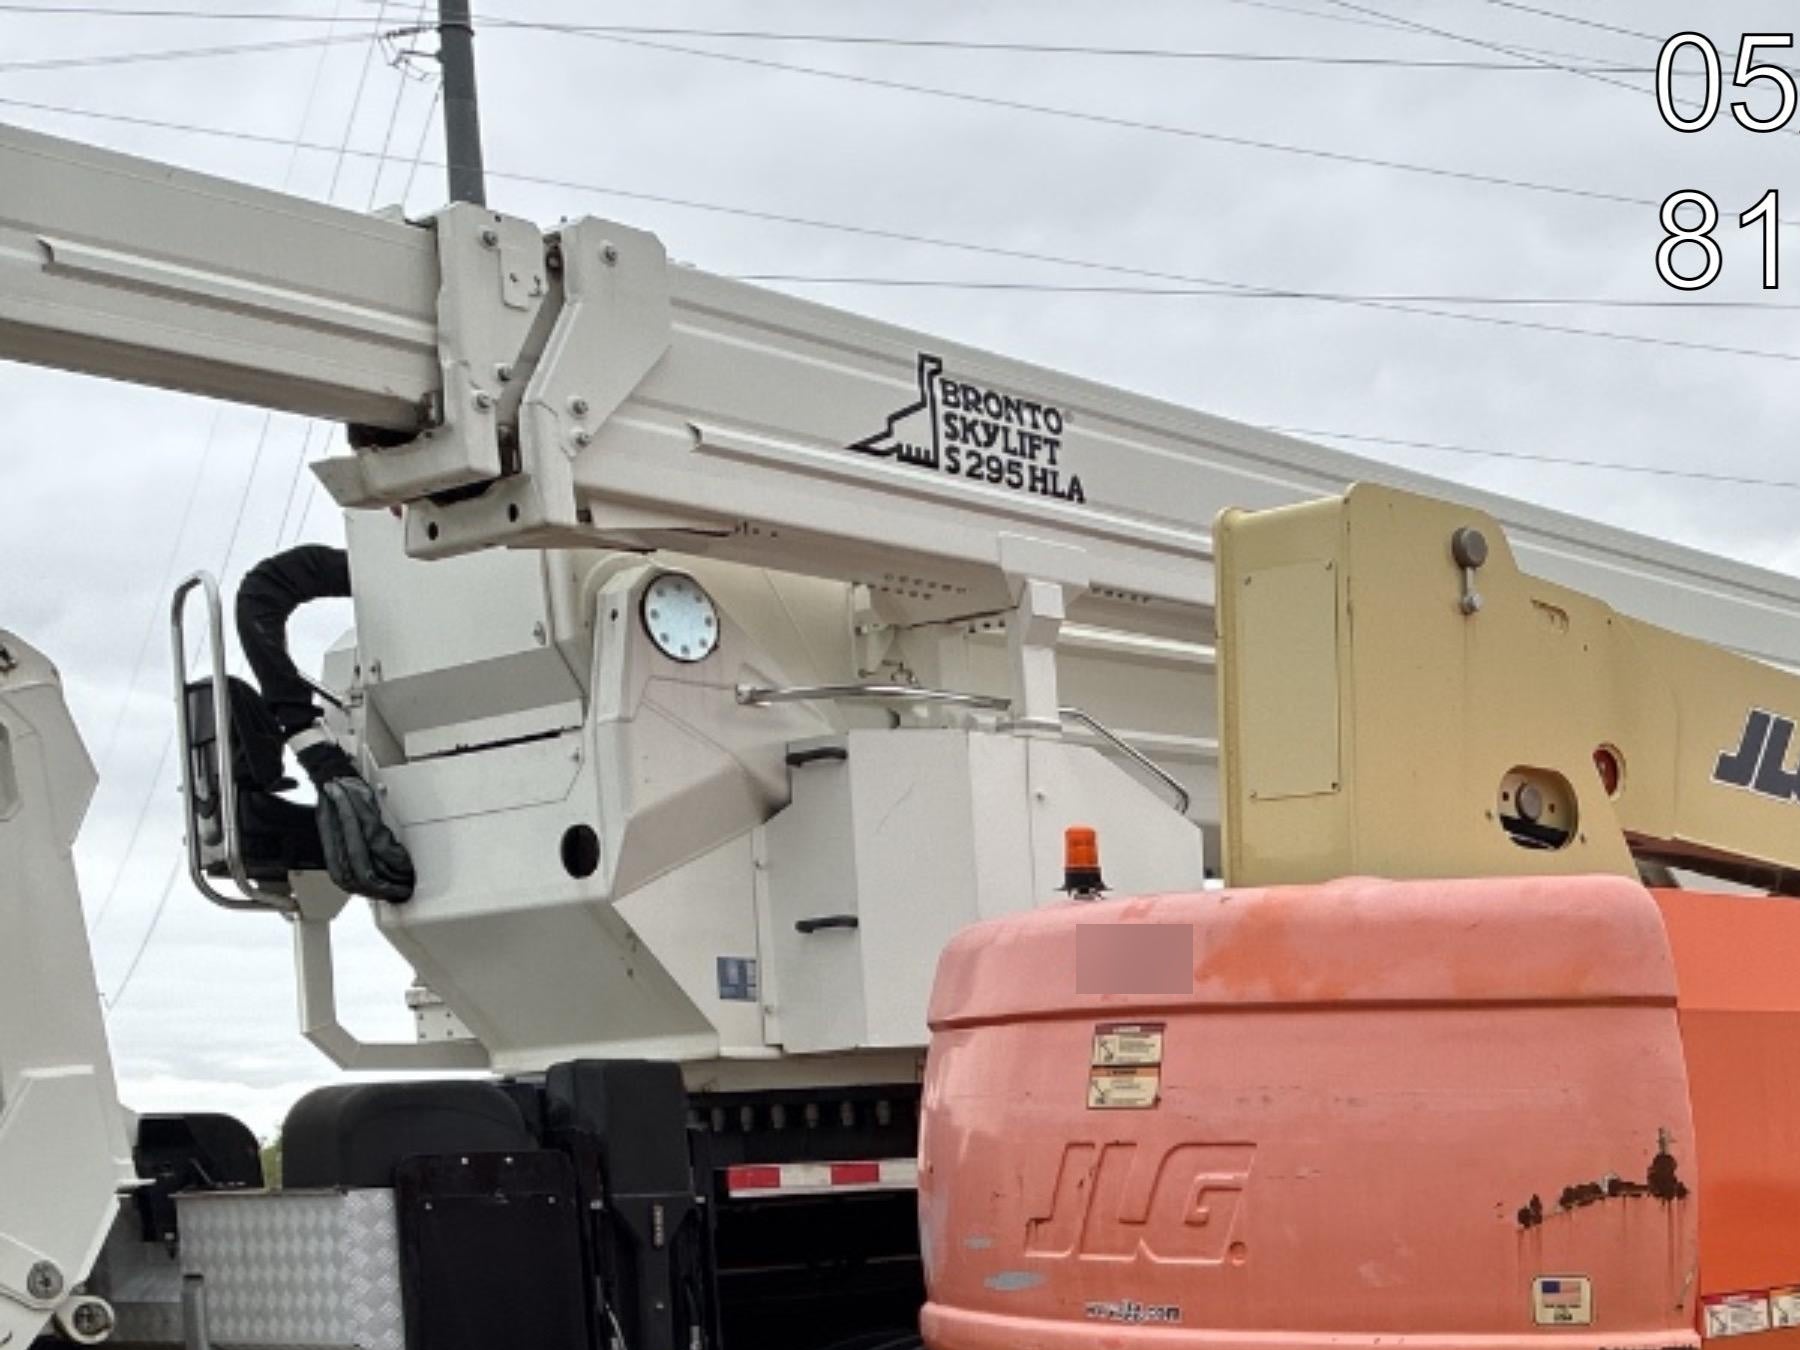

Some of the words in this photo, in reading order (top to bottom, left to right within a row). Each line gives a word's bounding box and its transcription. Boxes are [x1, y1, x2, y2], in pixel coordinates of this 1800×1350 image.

[939, 377, 1064, 436] BRONTO
[943, 412, 1061, 466] SKYLIFT
[1024, 1142, 1257, 1264] JLG
